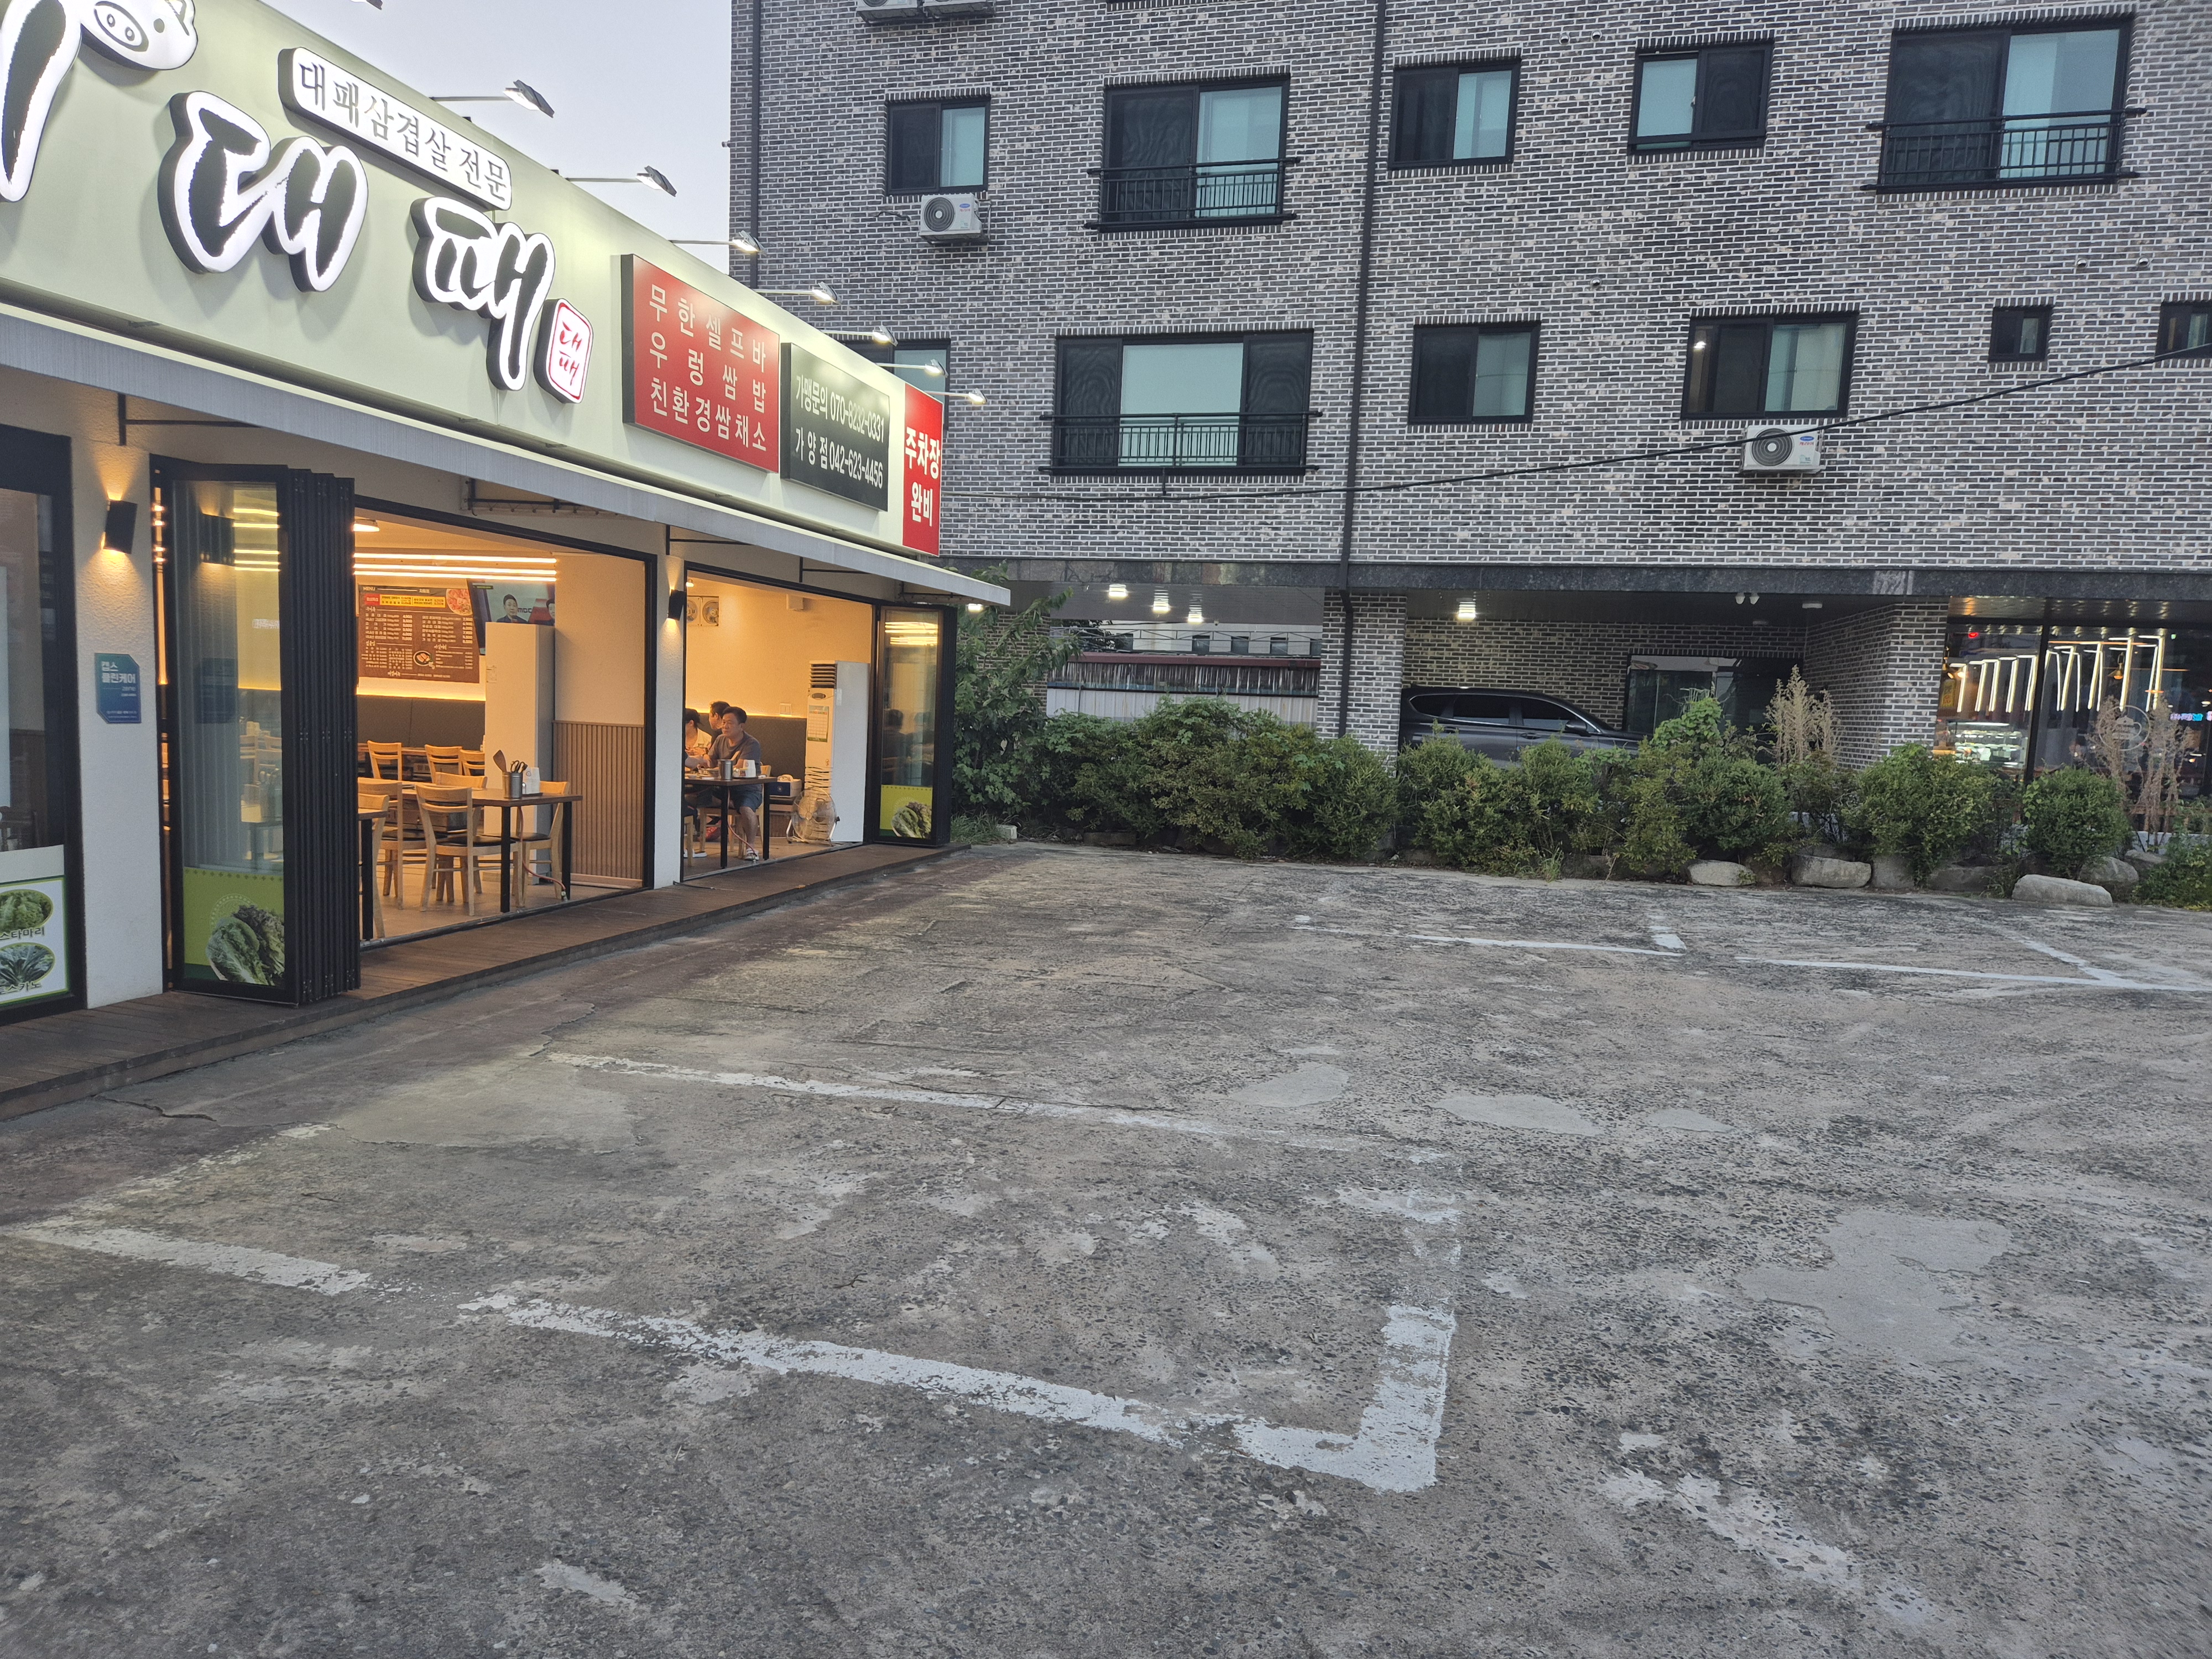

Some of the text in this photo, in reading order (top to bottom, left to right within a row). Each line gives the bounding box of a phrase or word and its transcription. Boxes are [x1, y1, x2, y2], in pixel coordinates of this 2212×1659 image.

[299, 62, 507, 201] 대패삼겹살 전문
[649, 284, 766, 373] 무한셀프바
[649, 332, 766, 414] 우렁쌈밥
[650, 377, 766, 452] 친환경쌈채소
[796, 374, 884, 444] 가맹문의 070-8232-0331
[796, 427, 883, 489] 가양점 042-623-4456
[905, 426, 941, 479] 주차장
[911, 481, 933, 527] 완비
[101, 661, 119, 671] 캡스
